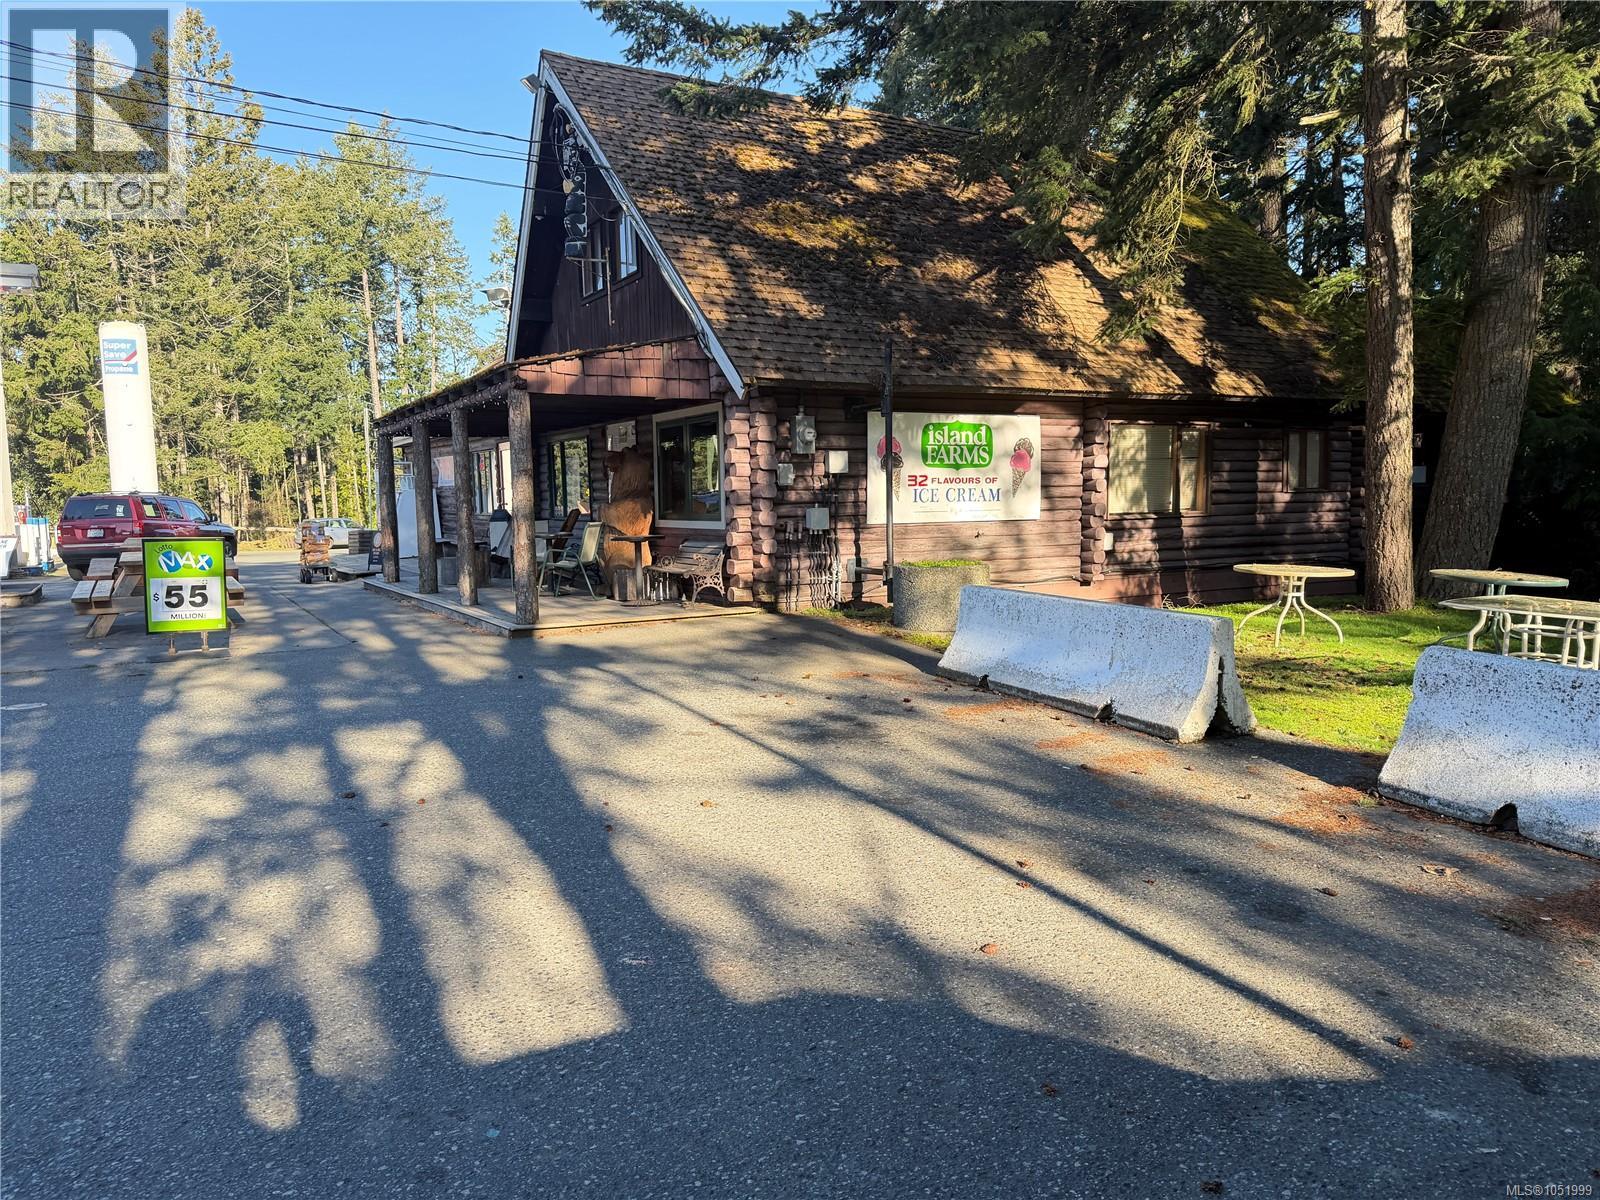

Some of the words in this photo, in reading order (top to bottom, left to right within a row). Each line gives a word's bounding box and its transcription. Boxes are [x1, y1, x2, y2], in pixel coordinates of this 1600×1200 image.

[103, 340, 132, 350] Super
[103, 351, 128, 360] Save
[928, 425, 987, 446] island
[925, 445, 990, 466] FARMS
[907, 474, 929, 487] 32
[931, 476, 981, 486] FLAVOURS
[984, 476, 998, 485] OF
[912, 488, 939, 503] ICE
[945, 487, 1002, 503] CREAM
